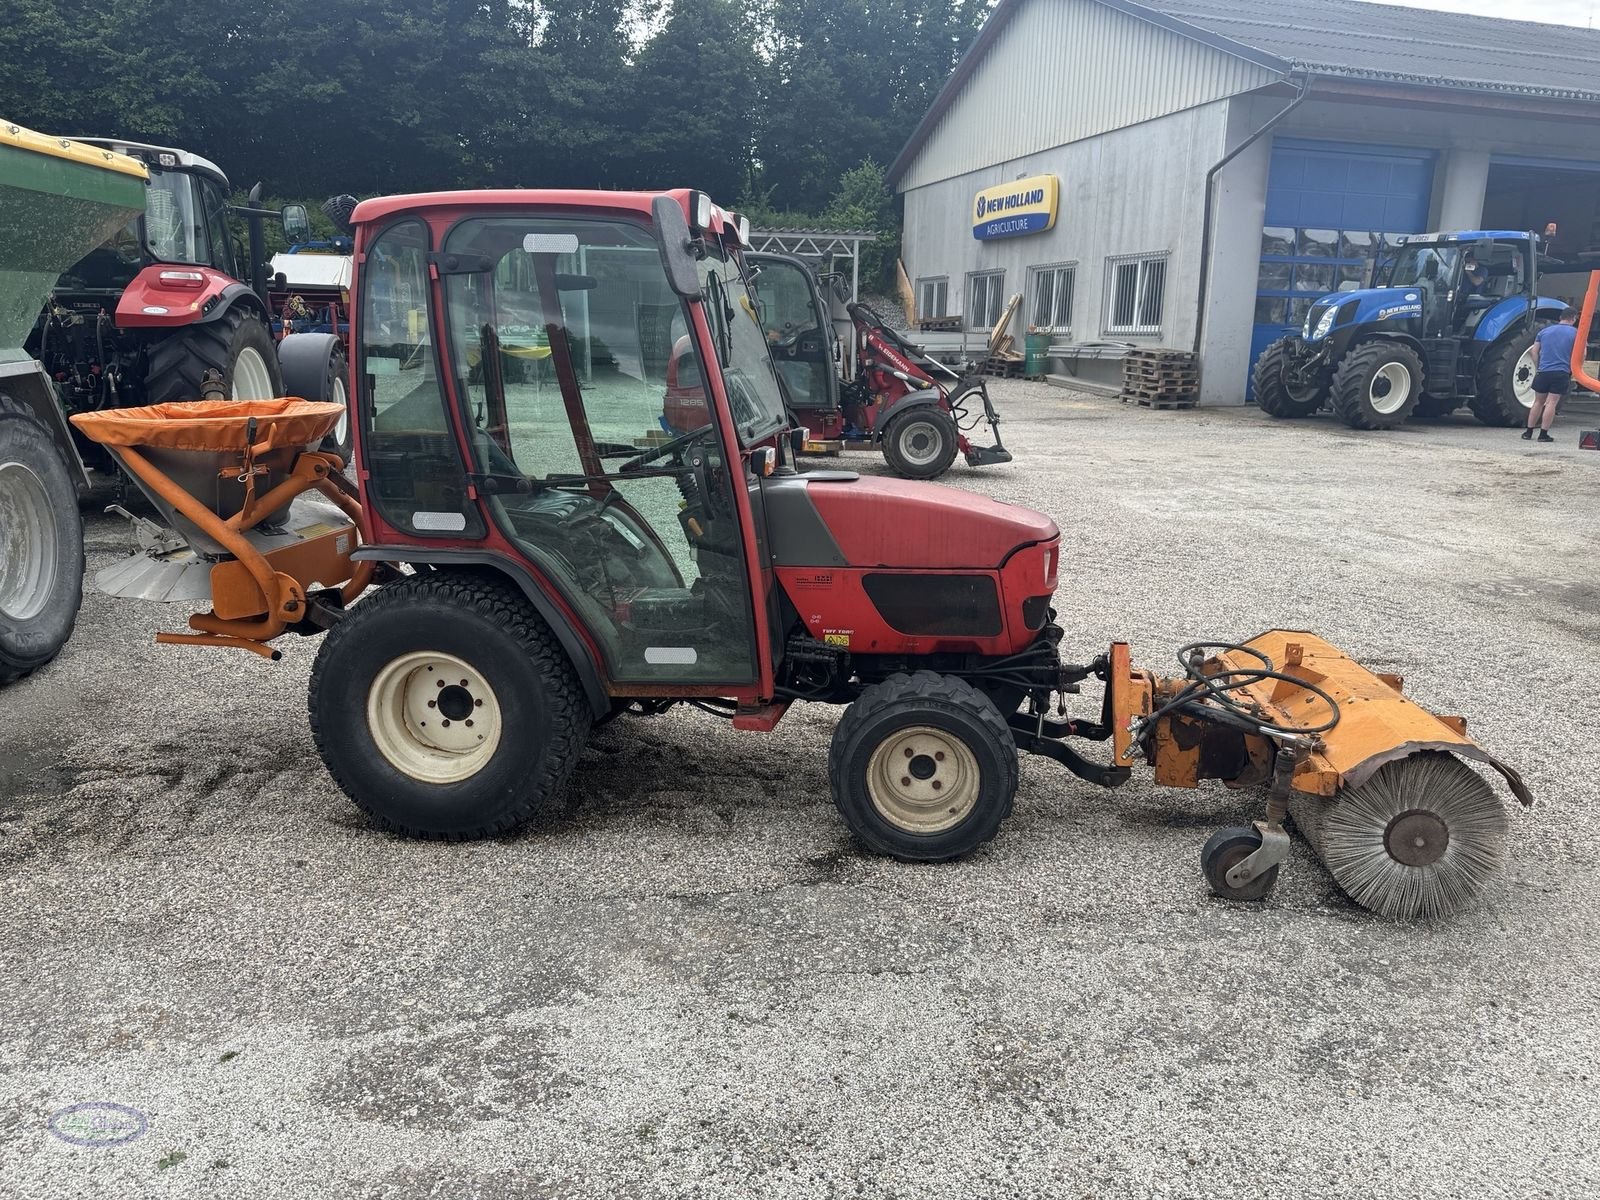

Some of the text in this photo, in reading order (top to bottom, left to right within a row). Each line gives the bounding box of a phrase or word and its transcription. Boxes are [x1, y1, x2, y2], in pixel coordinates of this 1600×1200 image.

[987, 189, 1044, 213] NEW HOLLAND
[987, 218, 1028, 235] AGRICULTURE
[1386, 304, 1422, 315] NEW HOLLAND
